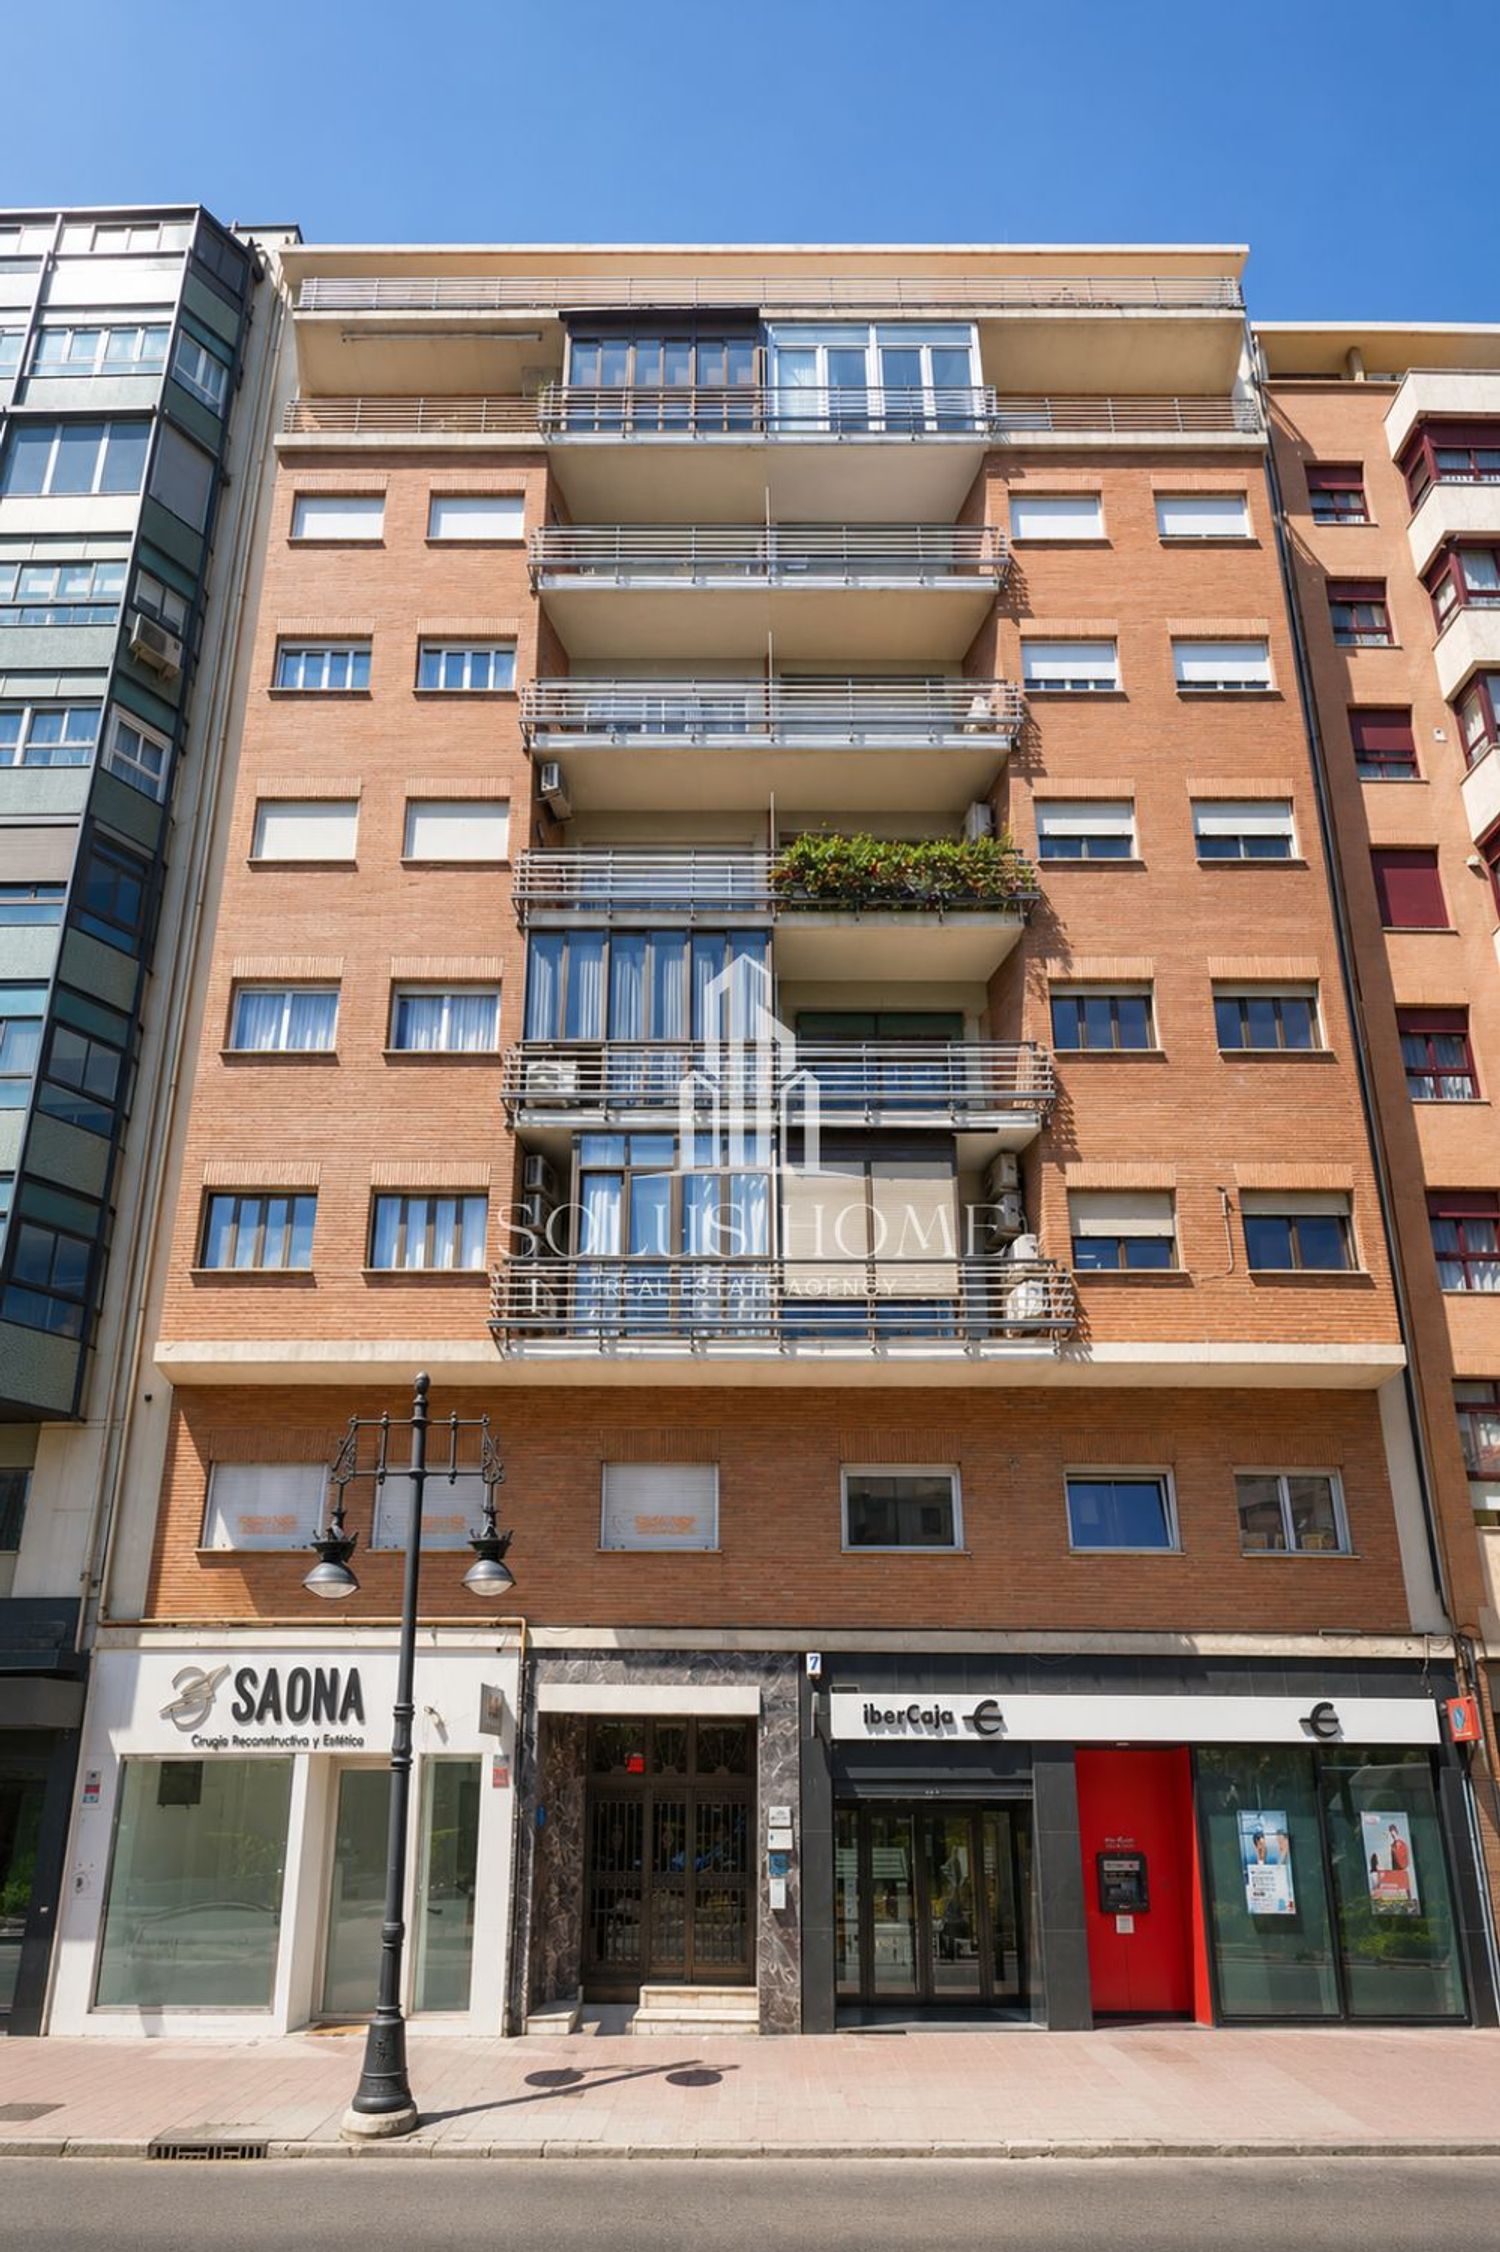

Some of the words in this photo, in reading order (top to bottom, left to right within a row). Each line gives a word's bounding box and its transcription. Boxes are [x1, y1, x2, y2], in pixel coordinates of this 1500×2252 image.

[809, 1656, 820, 1671] 7
[231, 1667, 365, 1723] SAONA
[863, 1703, 954, 1729] iberCaja
[232, 1734, 310, 1748] Reconstructiva
[312, 1737, 319, 1749] y
